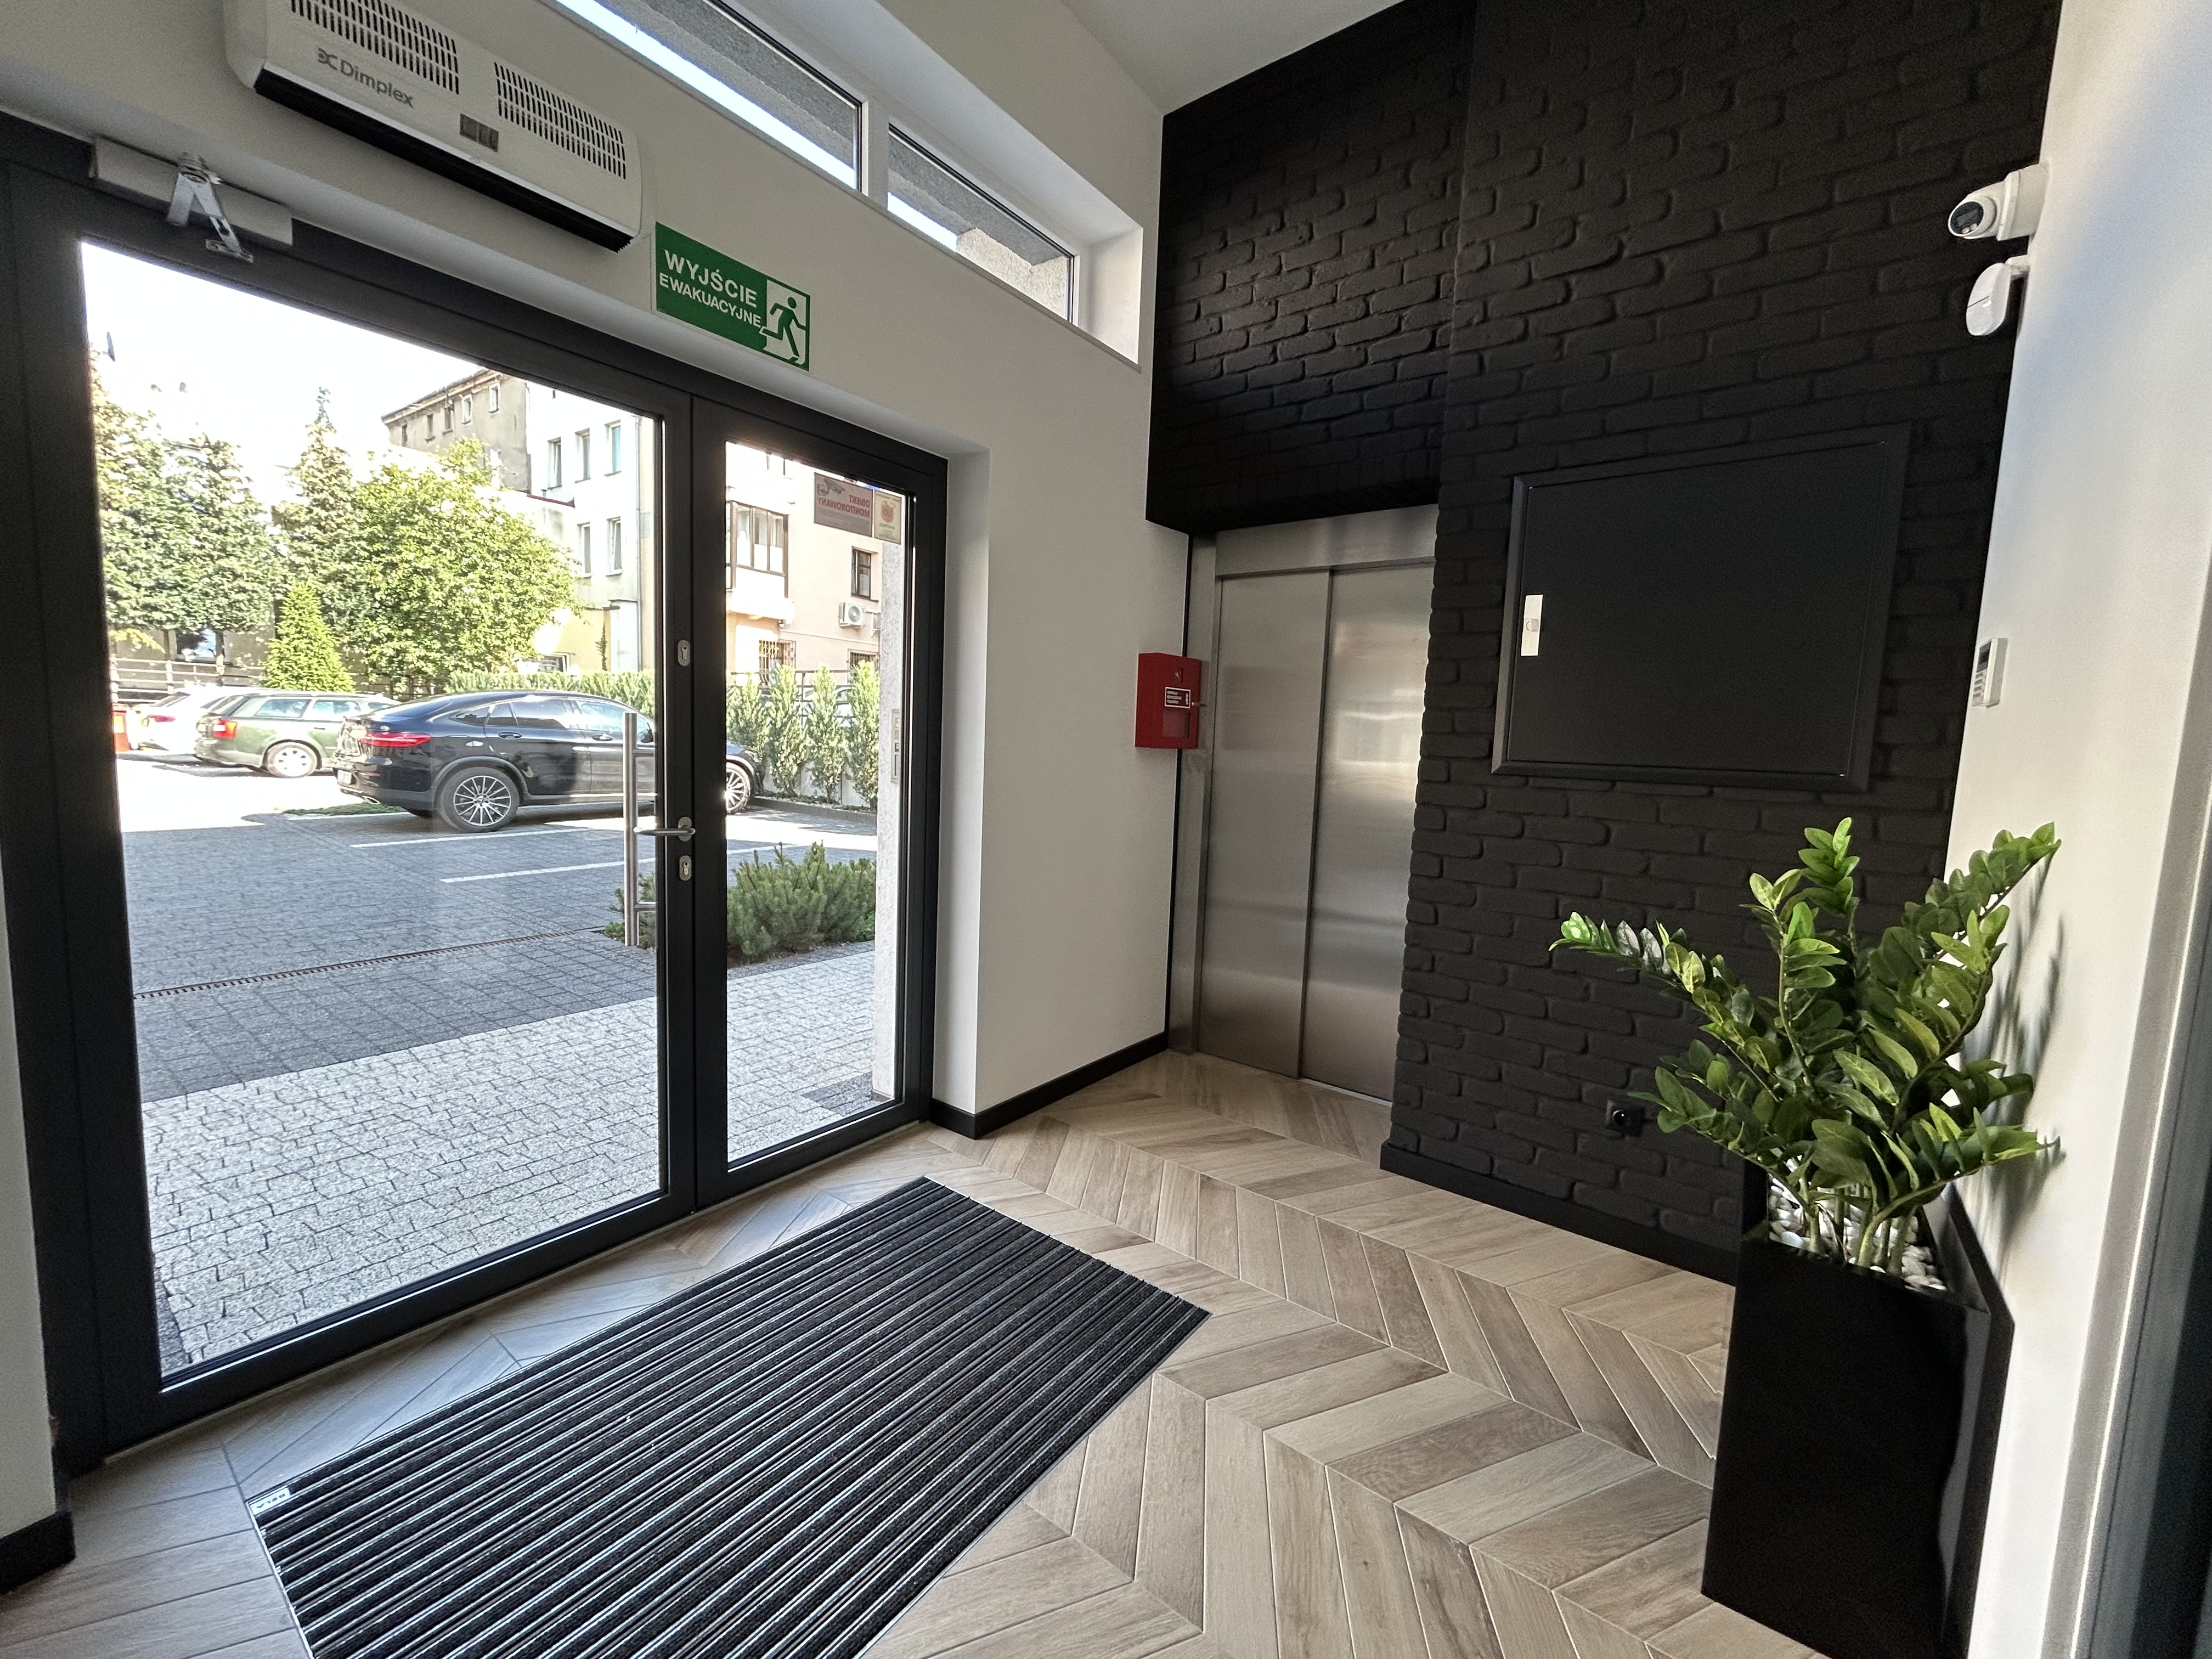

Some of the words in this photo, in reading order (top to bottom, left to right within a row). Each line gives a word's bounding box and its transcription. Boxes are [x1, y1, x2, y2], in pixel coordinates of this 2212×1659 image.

[340, 59, 414, 109] Dimplex
[659, 273, 763, 328] EWAKUACYJNE
[664, 249, 757, 308] WYJŚCIE
